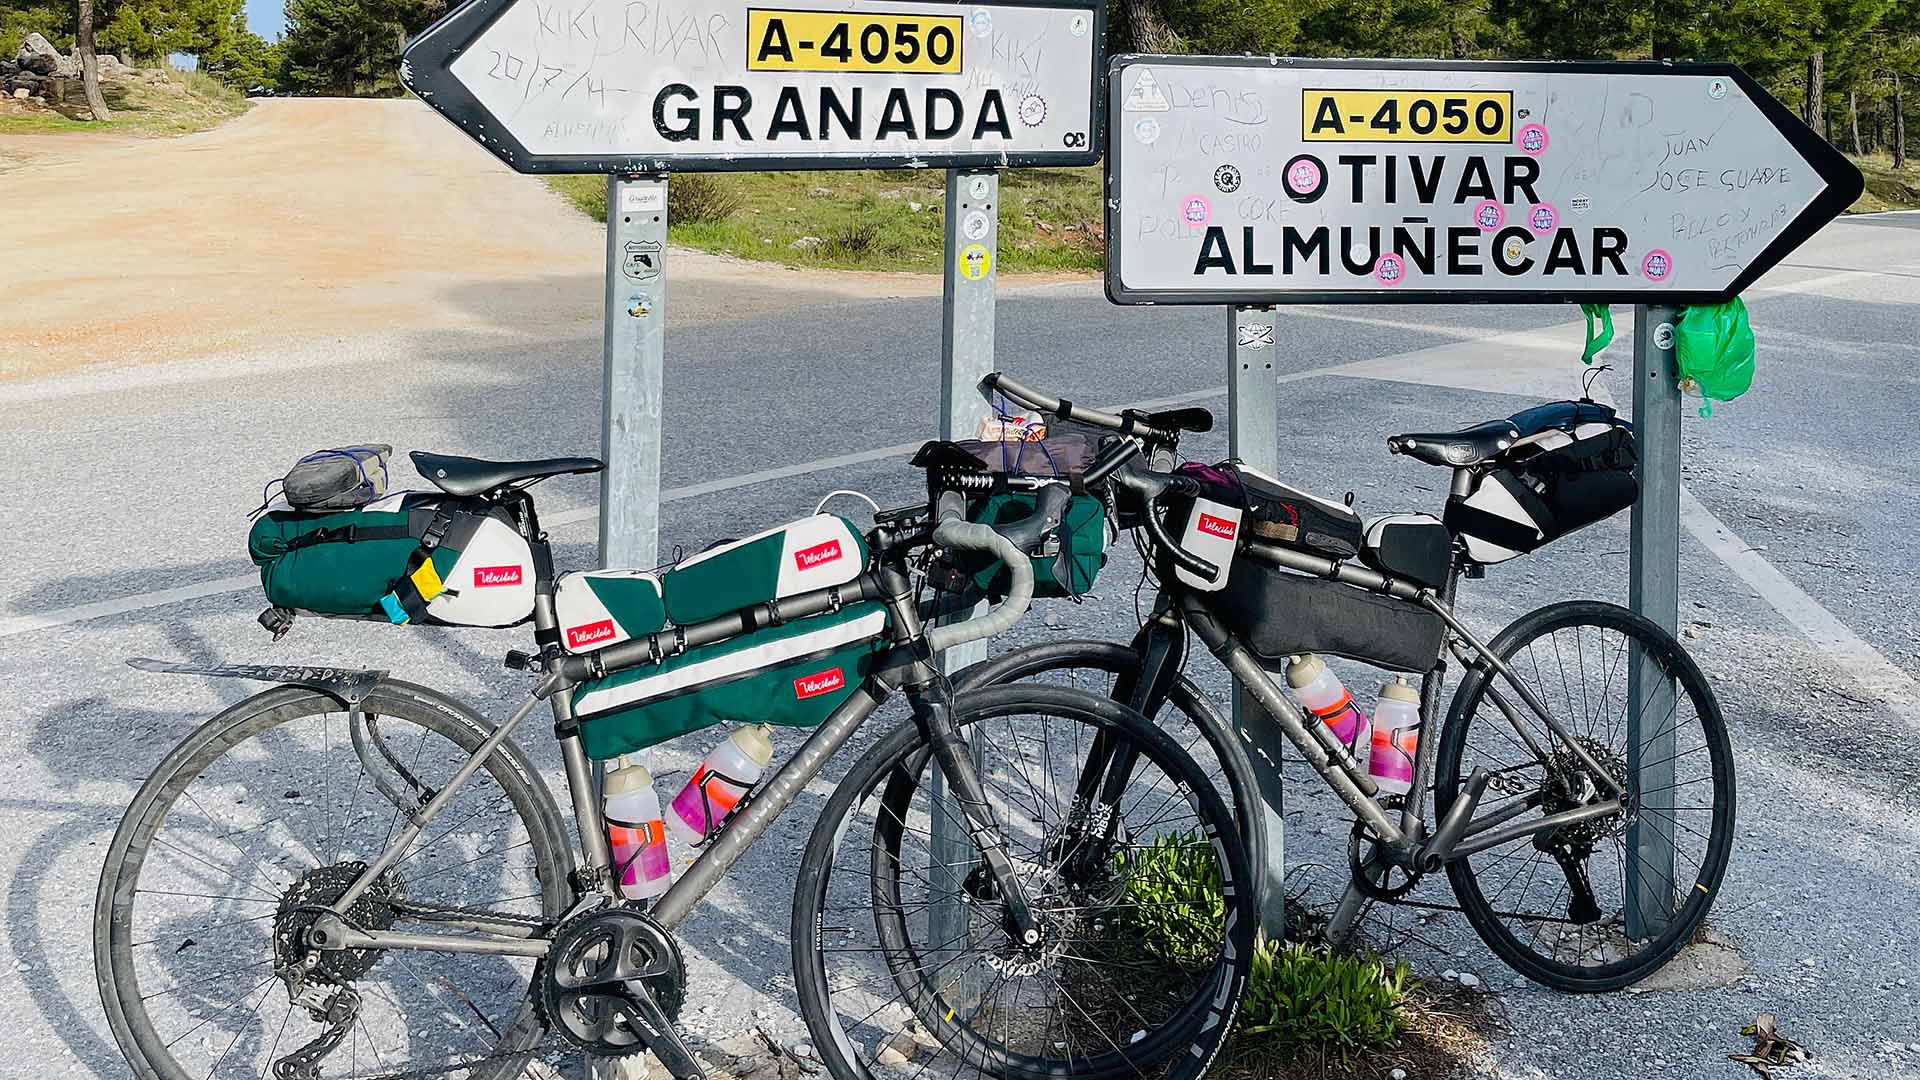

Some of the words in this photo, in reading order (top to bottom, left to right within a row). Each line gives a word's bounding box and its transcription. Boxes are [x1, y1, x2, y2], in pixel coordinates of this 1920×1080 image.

[757, 18, 955, 66] A-4050
[652, 83, 1013, 142] GRANADA
[1311, 97, 1505, 136] A-4050
[1281, 153, 1541, 204] OTIVAR
[1193, 216, 1629, 276] ALMUÑECAR
